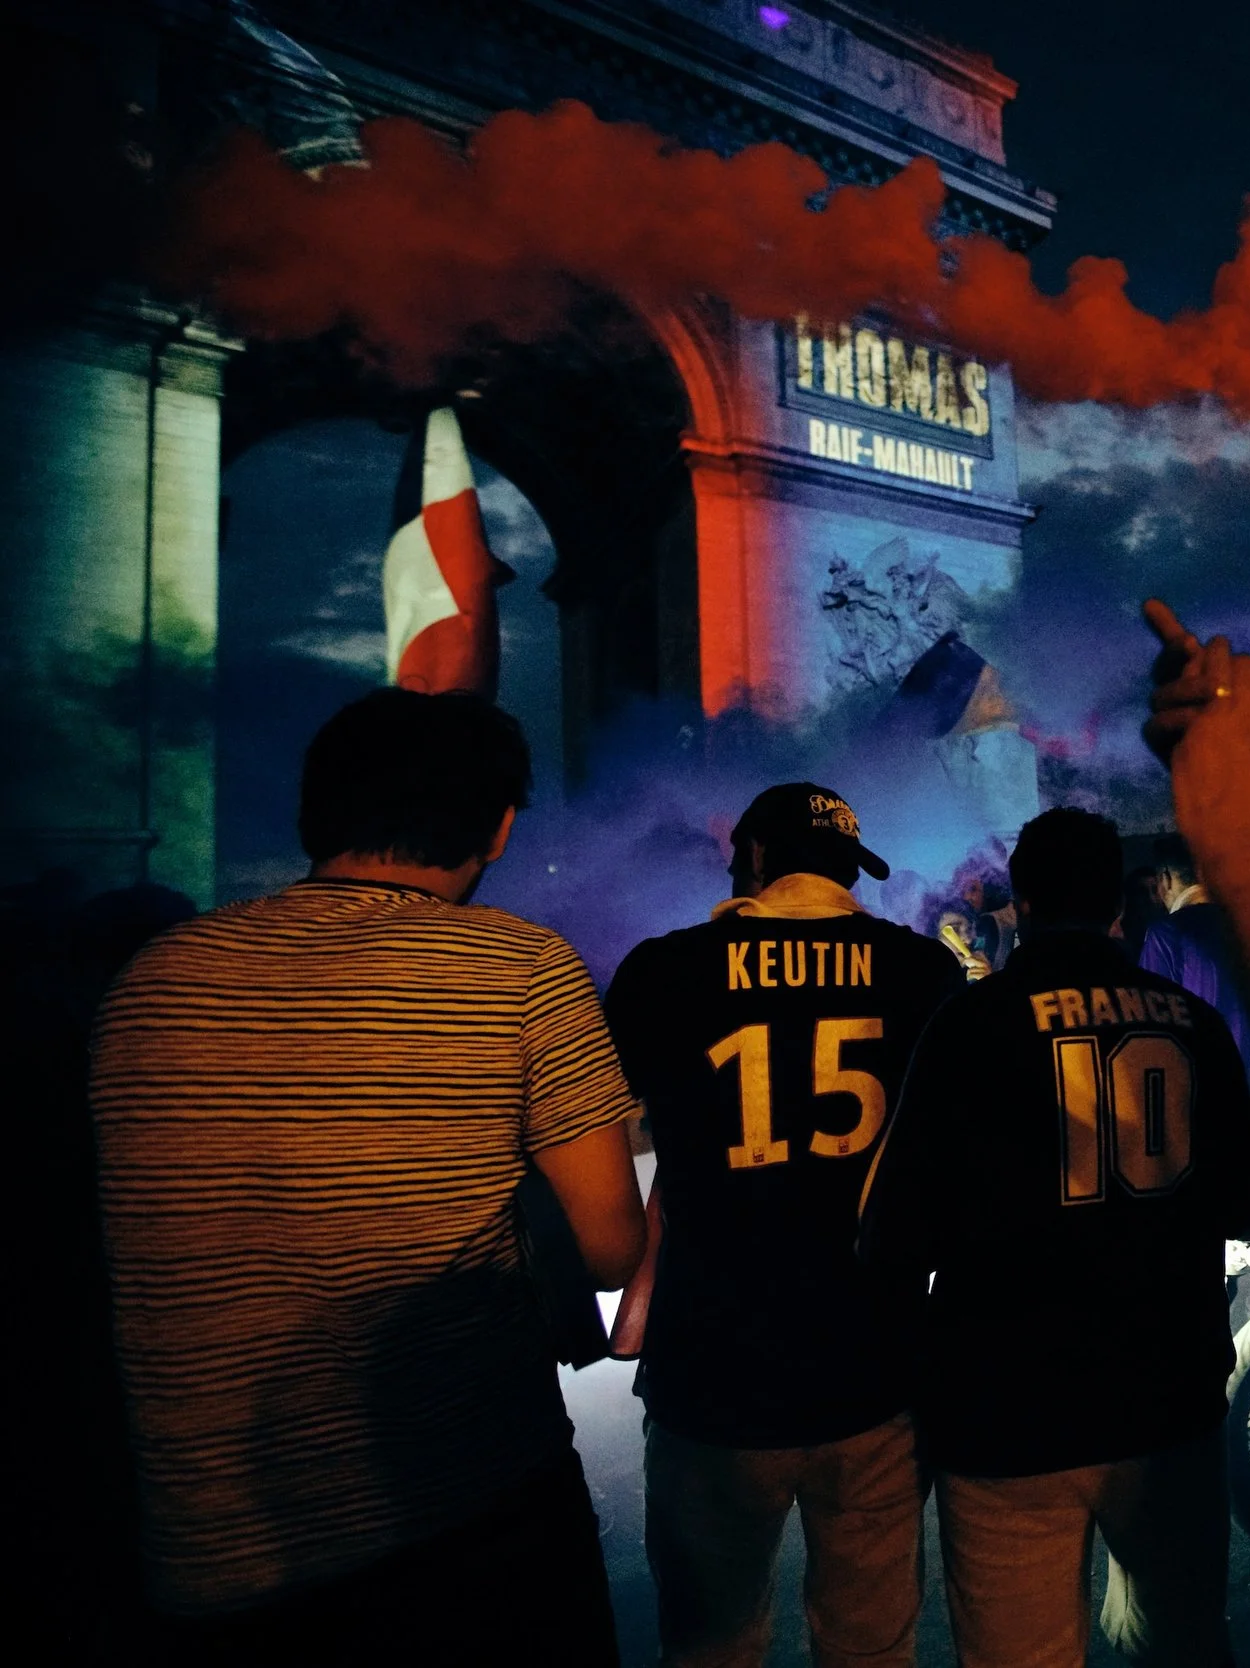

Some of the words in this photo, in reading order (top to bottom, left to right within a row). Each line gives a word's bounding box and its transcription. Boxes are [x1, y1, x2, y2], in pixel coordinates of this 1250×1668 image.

[727, 940, 872, 990] KEUTIN
[1029, 985, 1194, 1033] FRANCE
[706, 1016, 887, 1168] 15
[1052, 1031, 1197, 1206] 10
